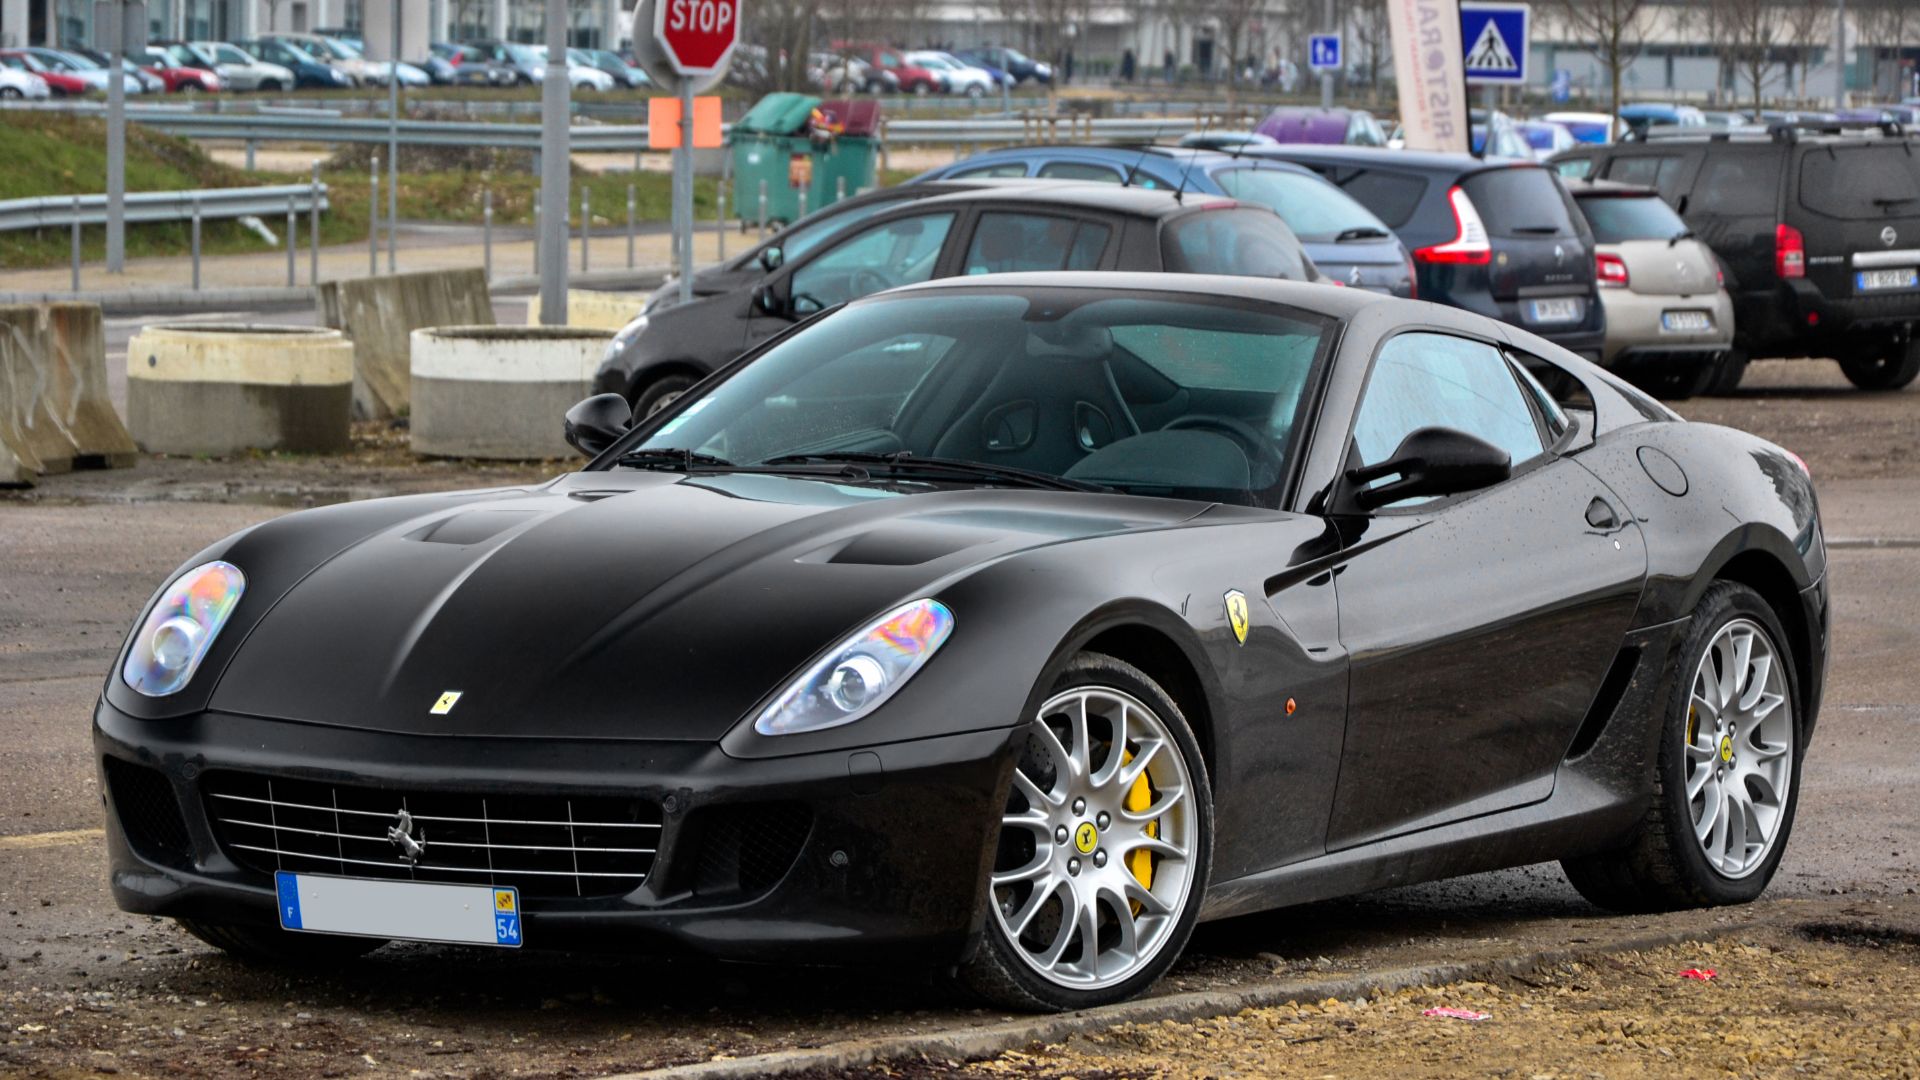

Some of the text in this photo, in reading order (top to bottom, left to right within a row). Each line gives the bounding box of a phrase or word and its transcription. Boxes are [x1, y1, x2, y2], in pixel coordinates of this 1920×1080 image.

[670, 0, 732, 33] STOP
[287, 906, 294, 919] F
[497, 918, 518, 940] 54
